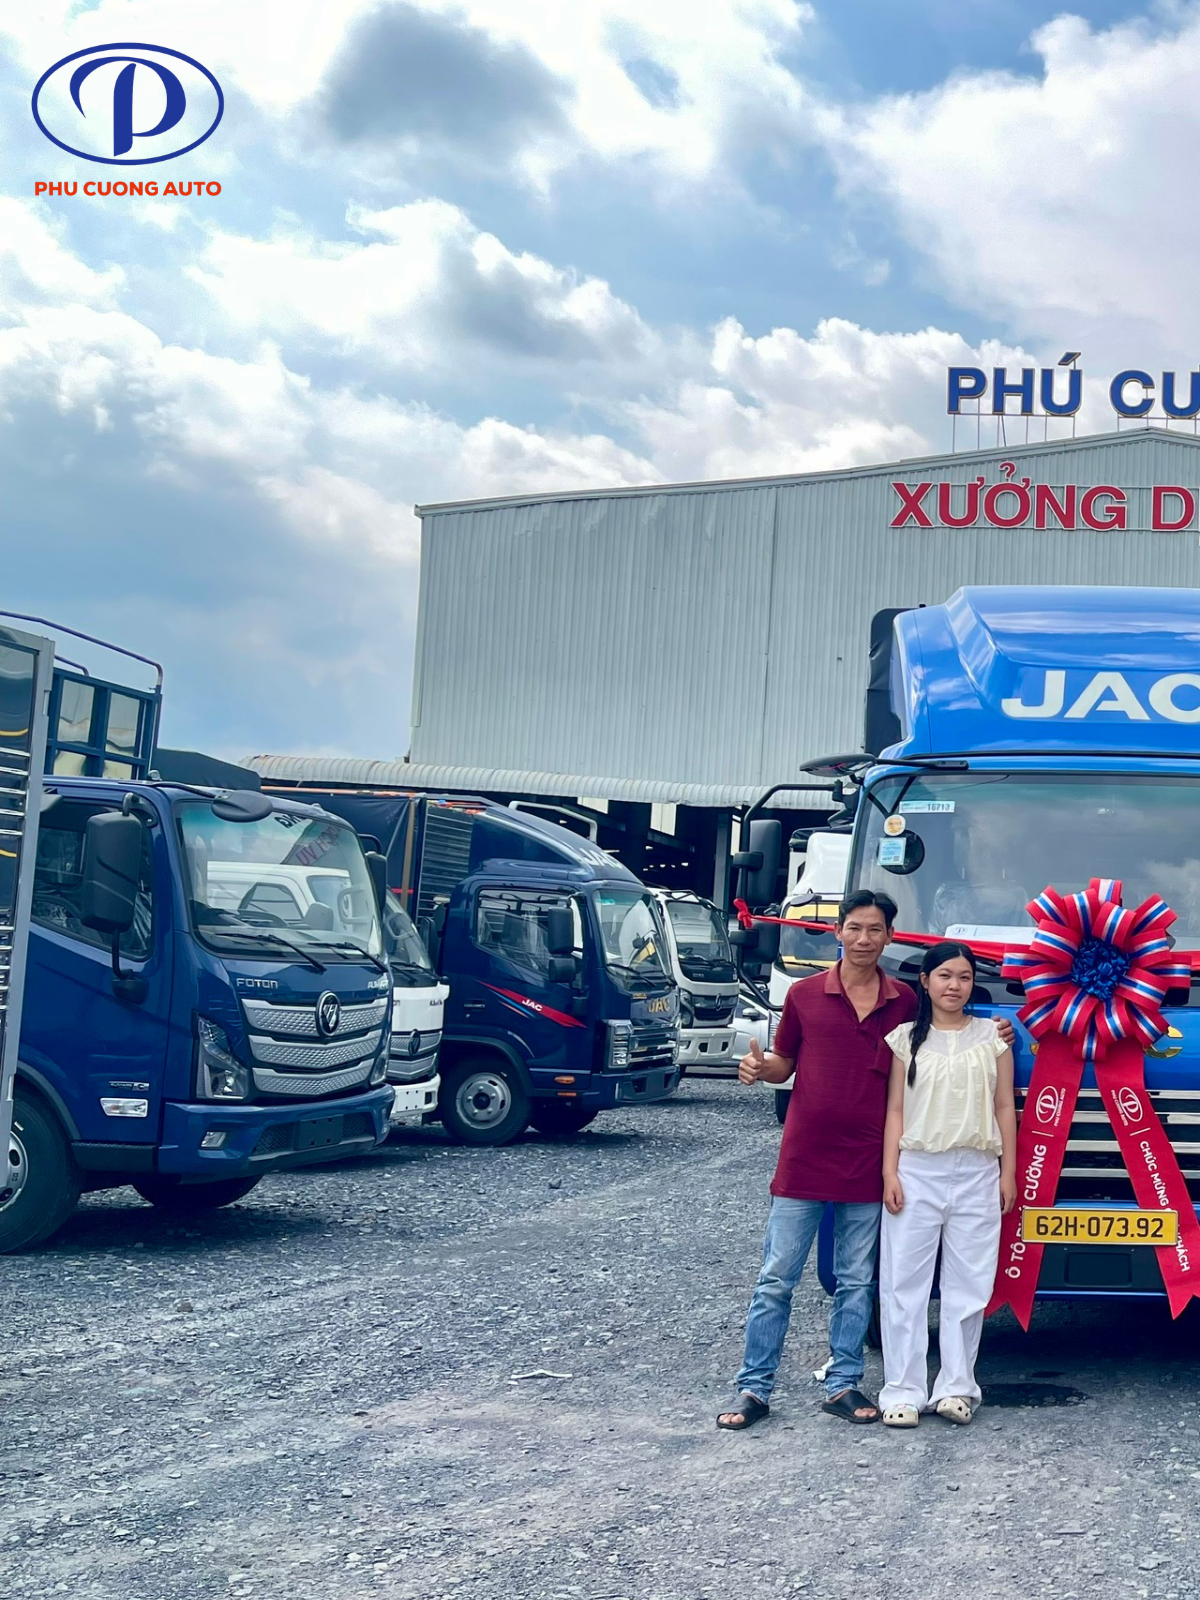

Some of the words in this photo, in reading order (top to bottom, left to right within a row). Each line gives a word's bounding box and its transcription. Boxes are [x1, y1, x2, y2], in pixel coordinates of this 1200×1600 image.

[946, 351, 1082, 417] PHÚ
[890, 461, 1129, 532] XƯỞNG
[522, 998, 543, 1012] JAC
[1023, 1144, 1047, 1201] CƯỜNG
[1139, 1140, 1158, 1172] CHÚC
[1150, 1172, 1170, 1207] MỪNG
[1035, 1215, 1164, 1239] 62H-073.92
[1005, 1262, 1021, 1279] Ô
[1009, 1240, 1026, 1262] TÔ
